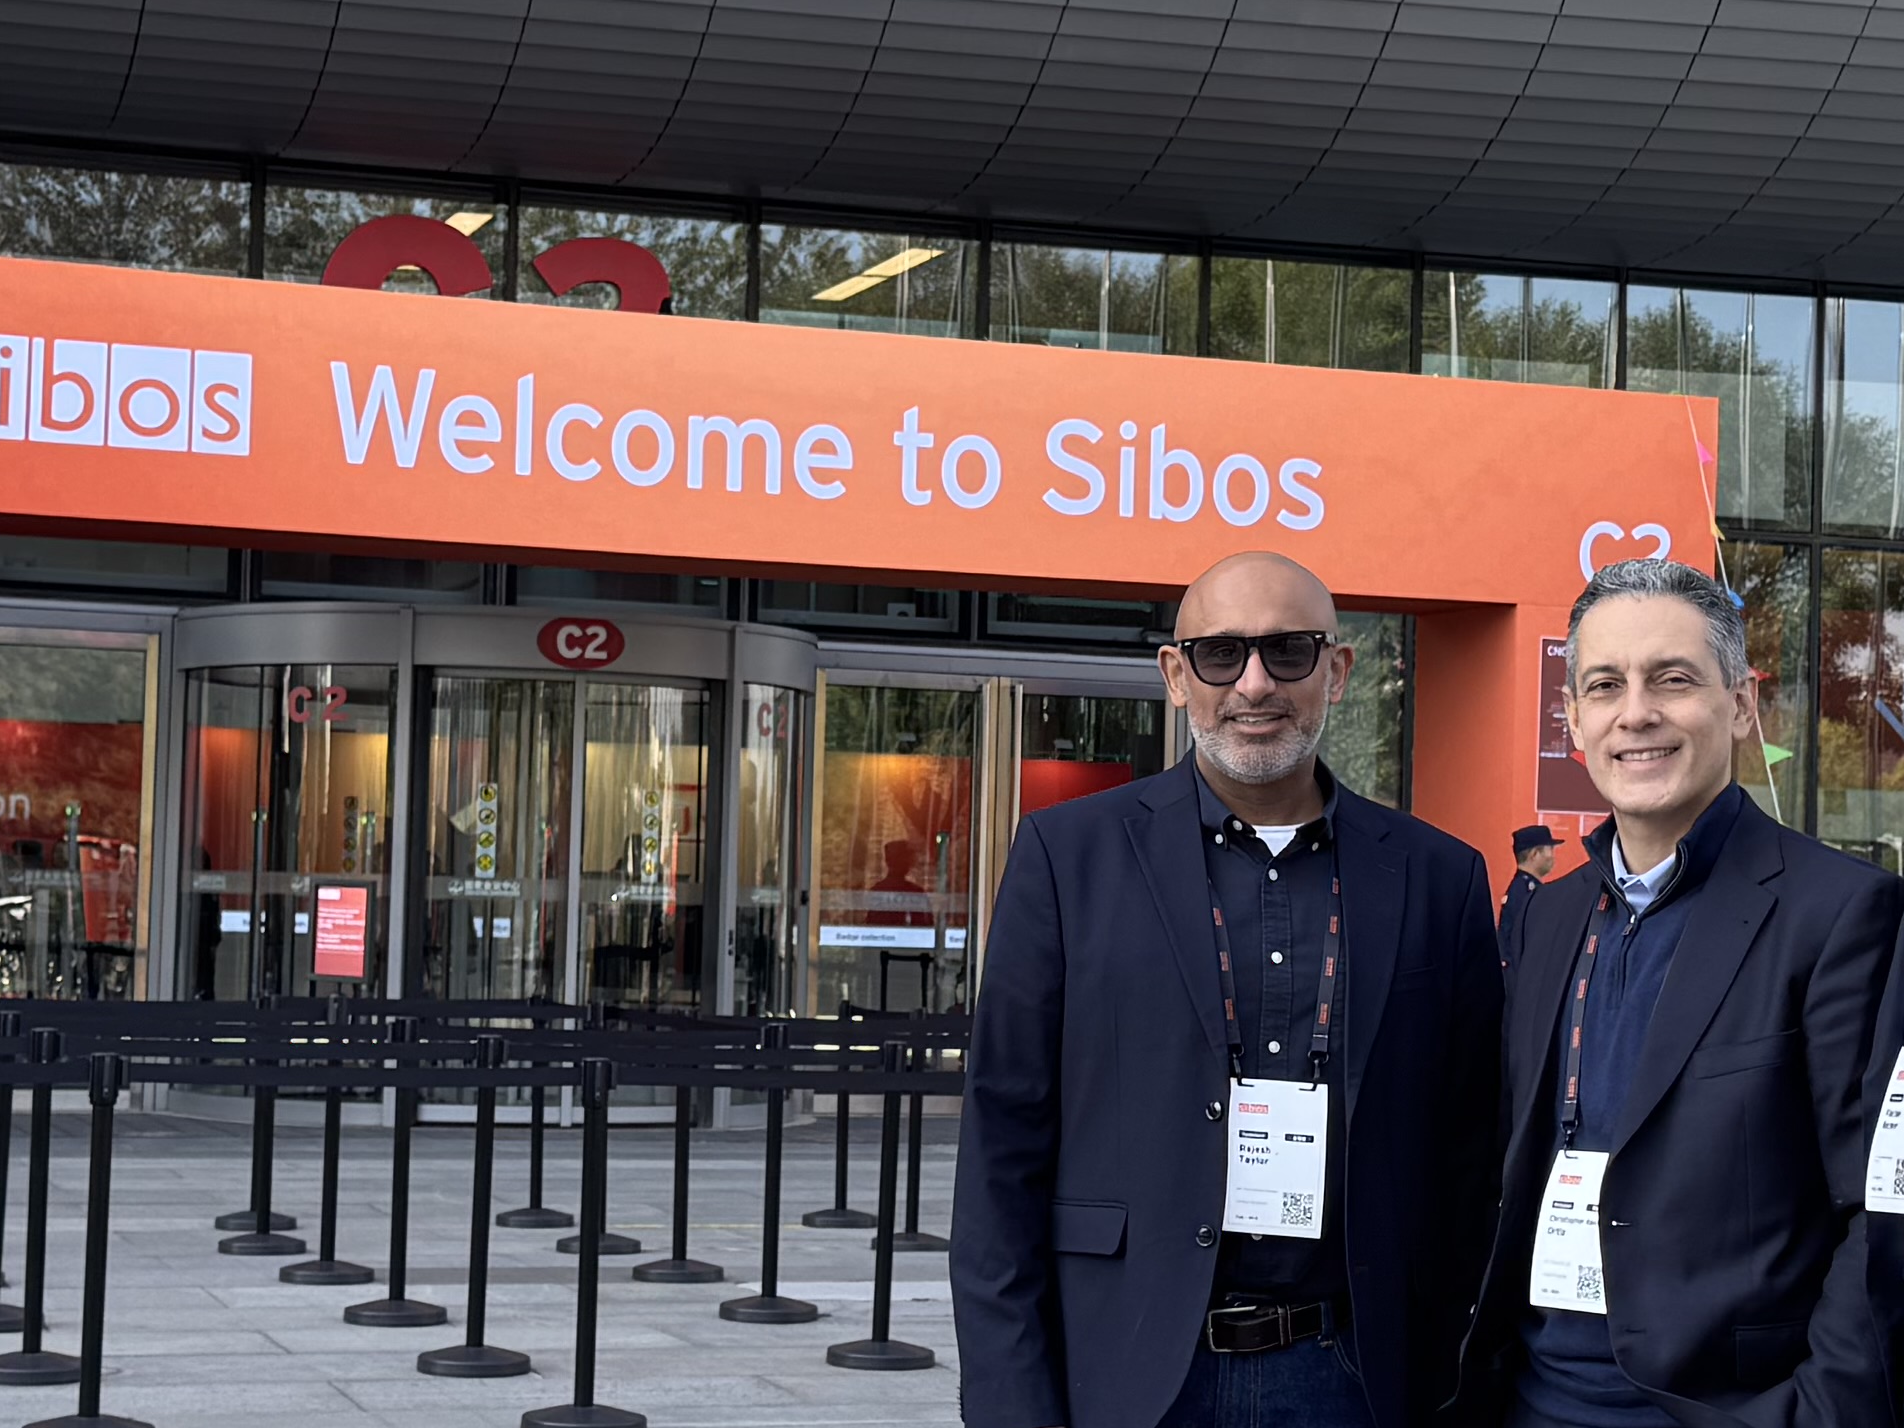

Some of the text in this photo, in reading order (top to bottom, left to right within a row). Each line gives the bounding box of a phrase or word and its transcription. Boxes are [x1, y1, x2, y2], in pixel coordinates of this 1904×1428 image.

[330, 360, 1325, 531] Welcome to Sibos
[556, 624, 608, 660] C2
[1547, 645, 1568, 657] CNC
[288, 686, 349, 723] C2
[757, 702, 789, 739] C2
